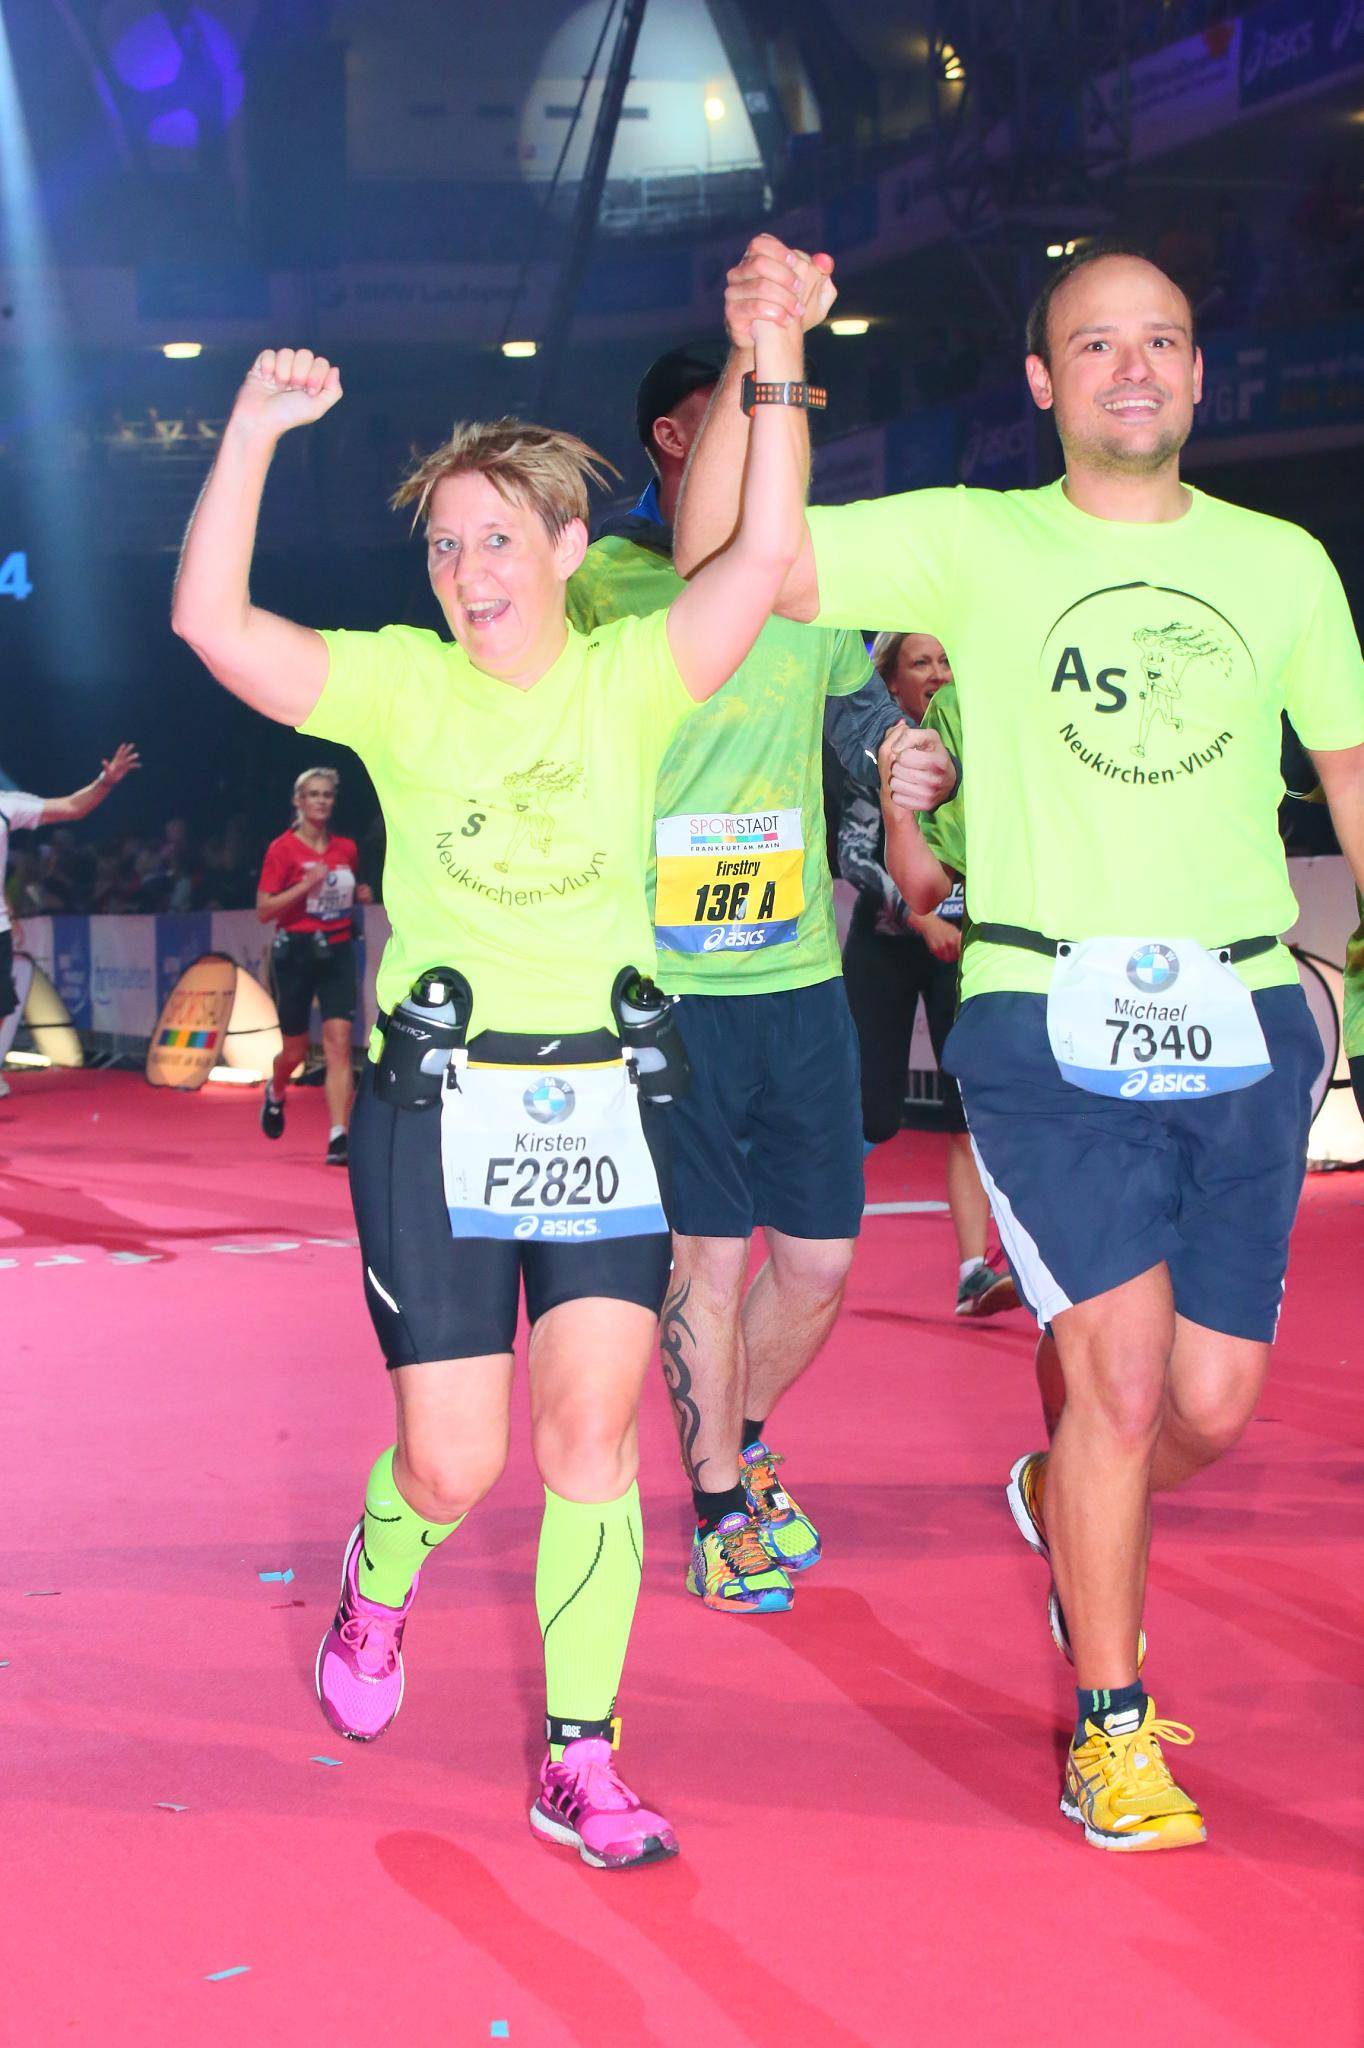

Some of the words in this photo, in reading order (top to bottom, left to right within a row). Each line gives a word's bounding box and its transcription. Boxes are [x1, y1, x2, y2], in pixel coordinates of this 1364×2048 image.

[1059, 723, 1233, 785] Neukirchen-Vluyn
[690, 815, 779, 835] SPORTSTADT
[436, 831, 607, 906] Neukirchen-Vluyn
[716, 860, 761, 876] Firsttry
[694, 882, 750, 921] 136
[757, 881, 776, 919] A
[725, 929, 765, 946] asics
[1114, 998, 1188, 1022] Michael
[1105, 1018, 1212, 1065] 7340
[1150, 1074, 1207, 1093] asics
[515, 1132, 587, 1152] Kirsten
[484, 1155, 619, 1207] F2820
[540, 1217, 598, 1237] asics
[561, 1724, 581, 1738] ROSE
